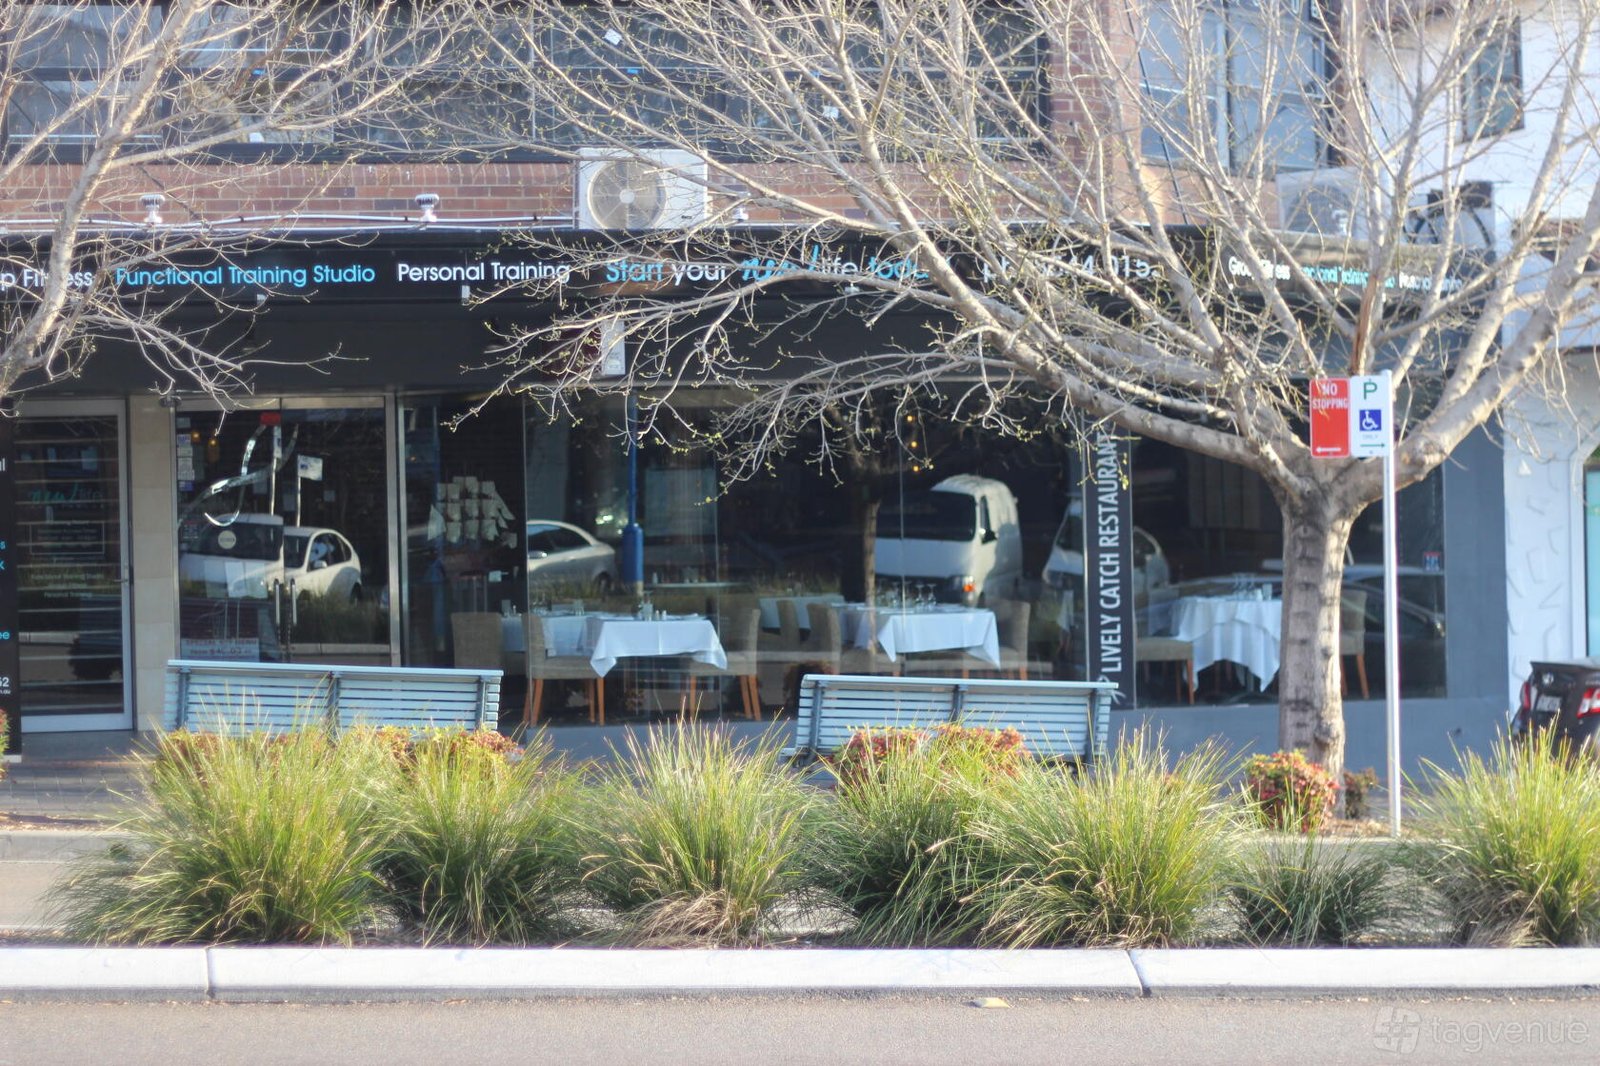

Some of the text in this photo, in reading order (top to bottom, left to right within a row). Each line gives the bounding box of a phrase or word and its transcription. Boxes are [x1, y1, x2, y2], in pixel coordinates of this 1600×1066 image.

[23, 268, 93, 287] Fitess
[116, 264, 375, 287] Functional Training Studio
[398, 261, 570, 283] Personal Training
[606, 259, 663, 282] Start
[671, 263, 726, 286] your
[1363, 382, 1378, 400] P
[1312, 398, 1348, 410] STOPPING
[1097, 431, 1122, 673] LIVELY CATCH RESTAURANT
